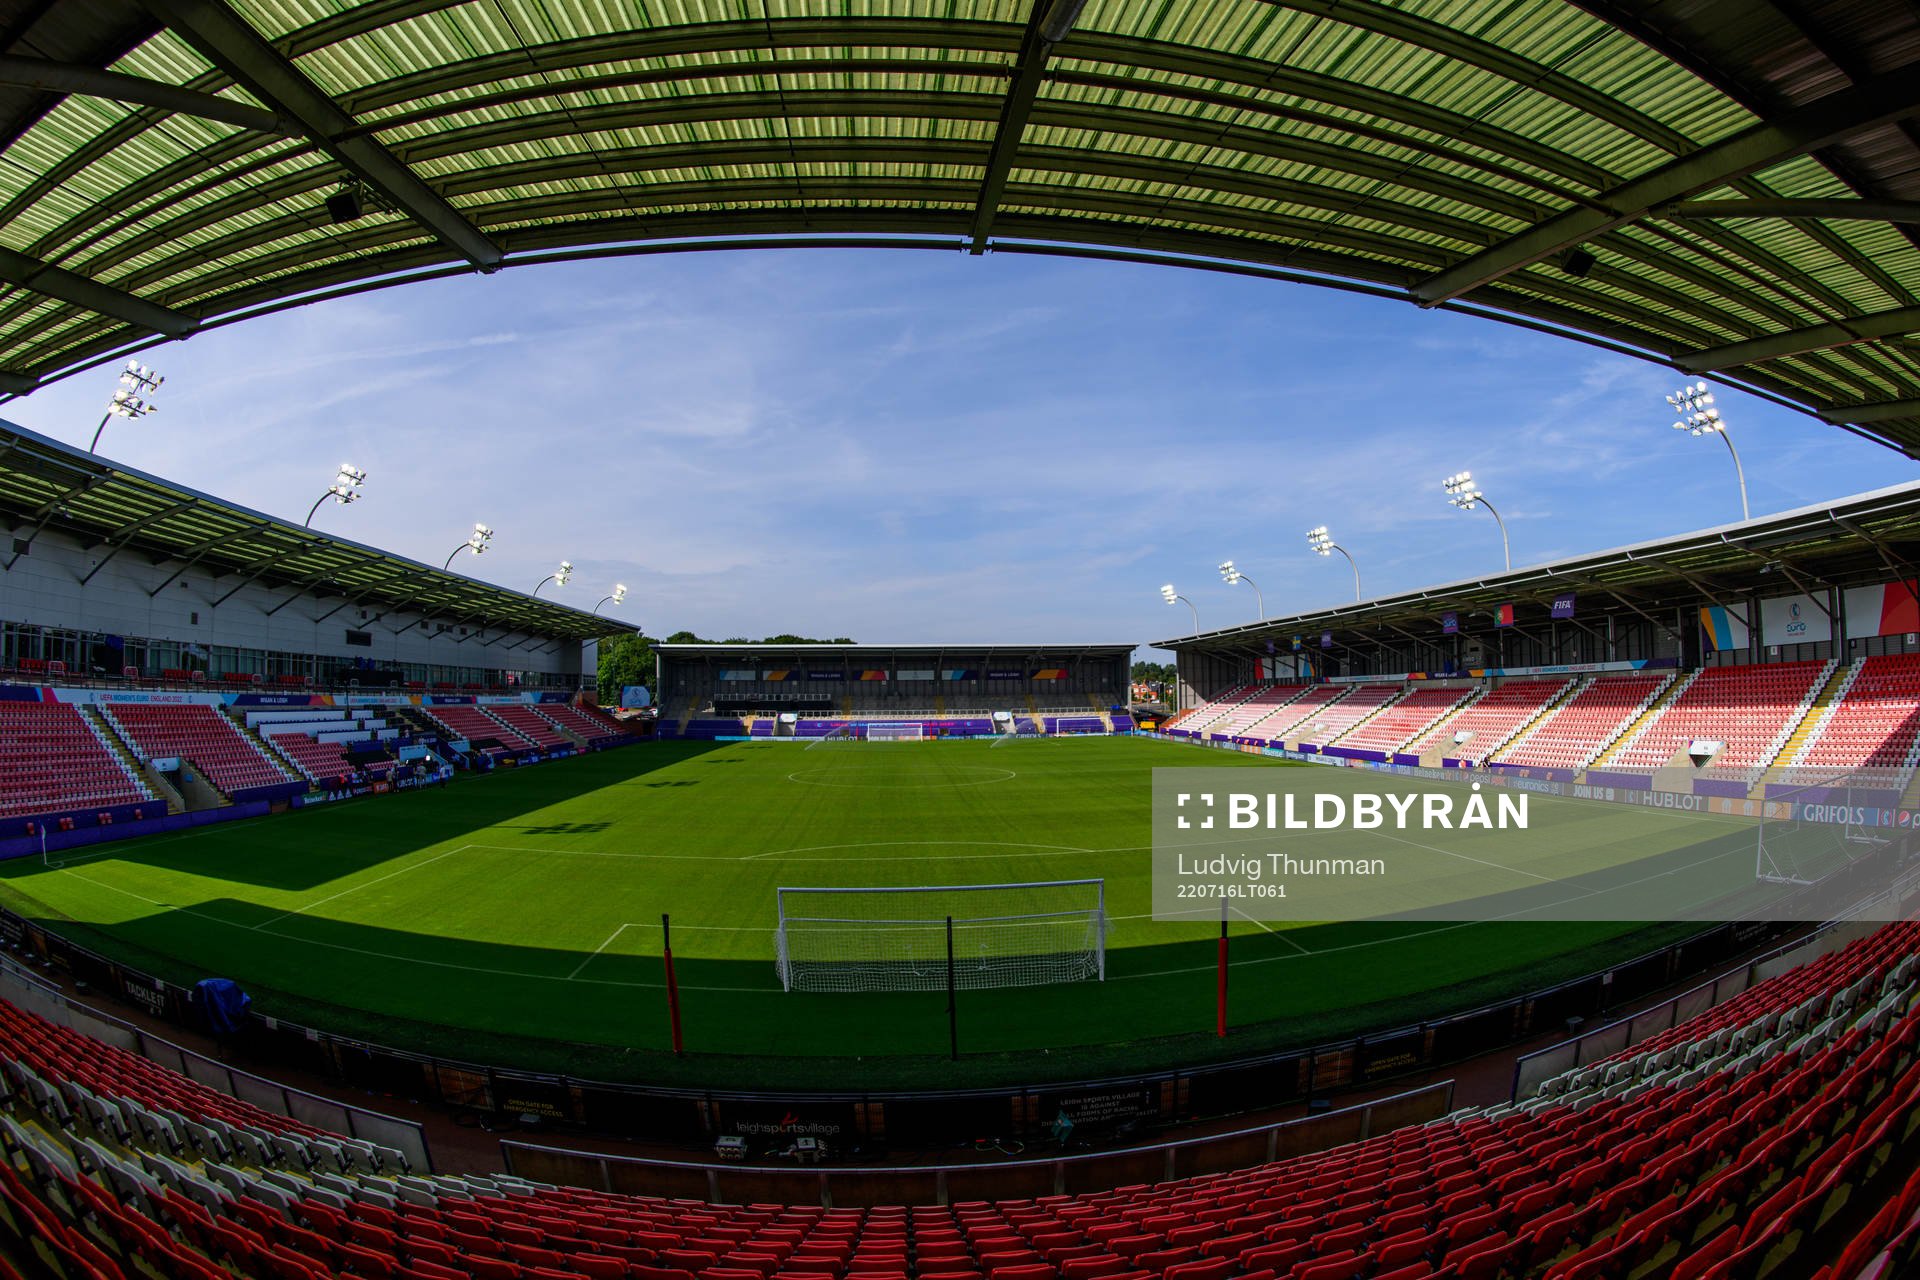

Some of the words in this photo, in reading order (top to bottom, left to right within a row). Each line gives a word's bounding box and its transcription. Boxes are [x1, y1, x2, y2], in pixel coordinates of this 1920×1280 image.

[1554, 600, 1571, 609] FIFA
[1469, 773, 1490, 784] pepsi
[1573, 784, 1592, 799] JOIN
[1593, 787, 1604, 800] US
[1643, 792, 1703, 811] HUBLOT
[1804, 804, 1864, 825] GRIFOLS
[126, 981, 157, 1004] TACKLE
[1090, 1101, 1119, 1109] AGAINST
